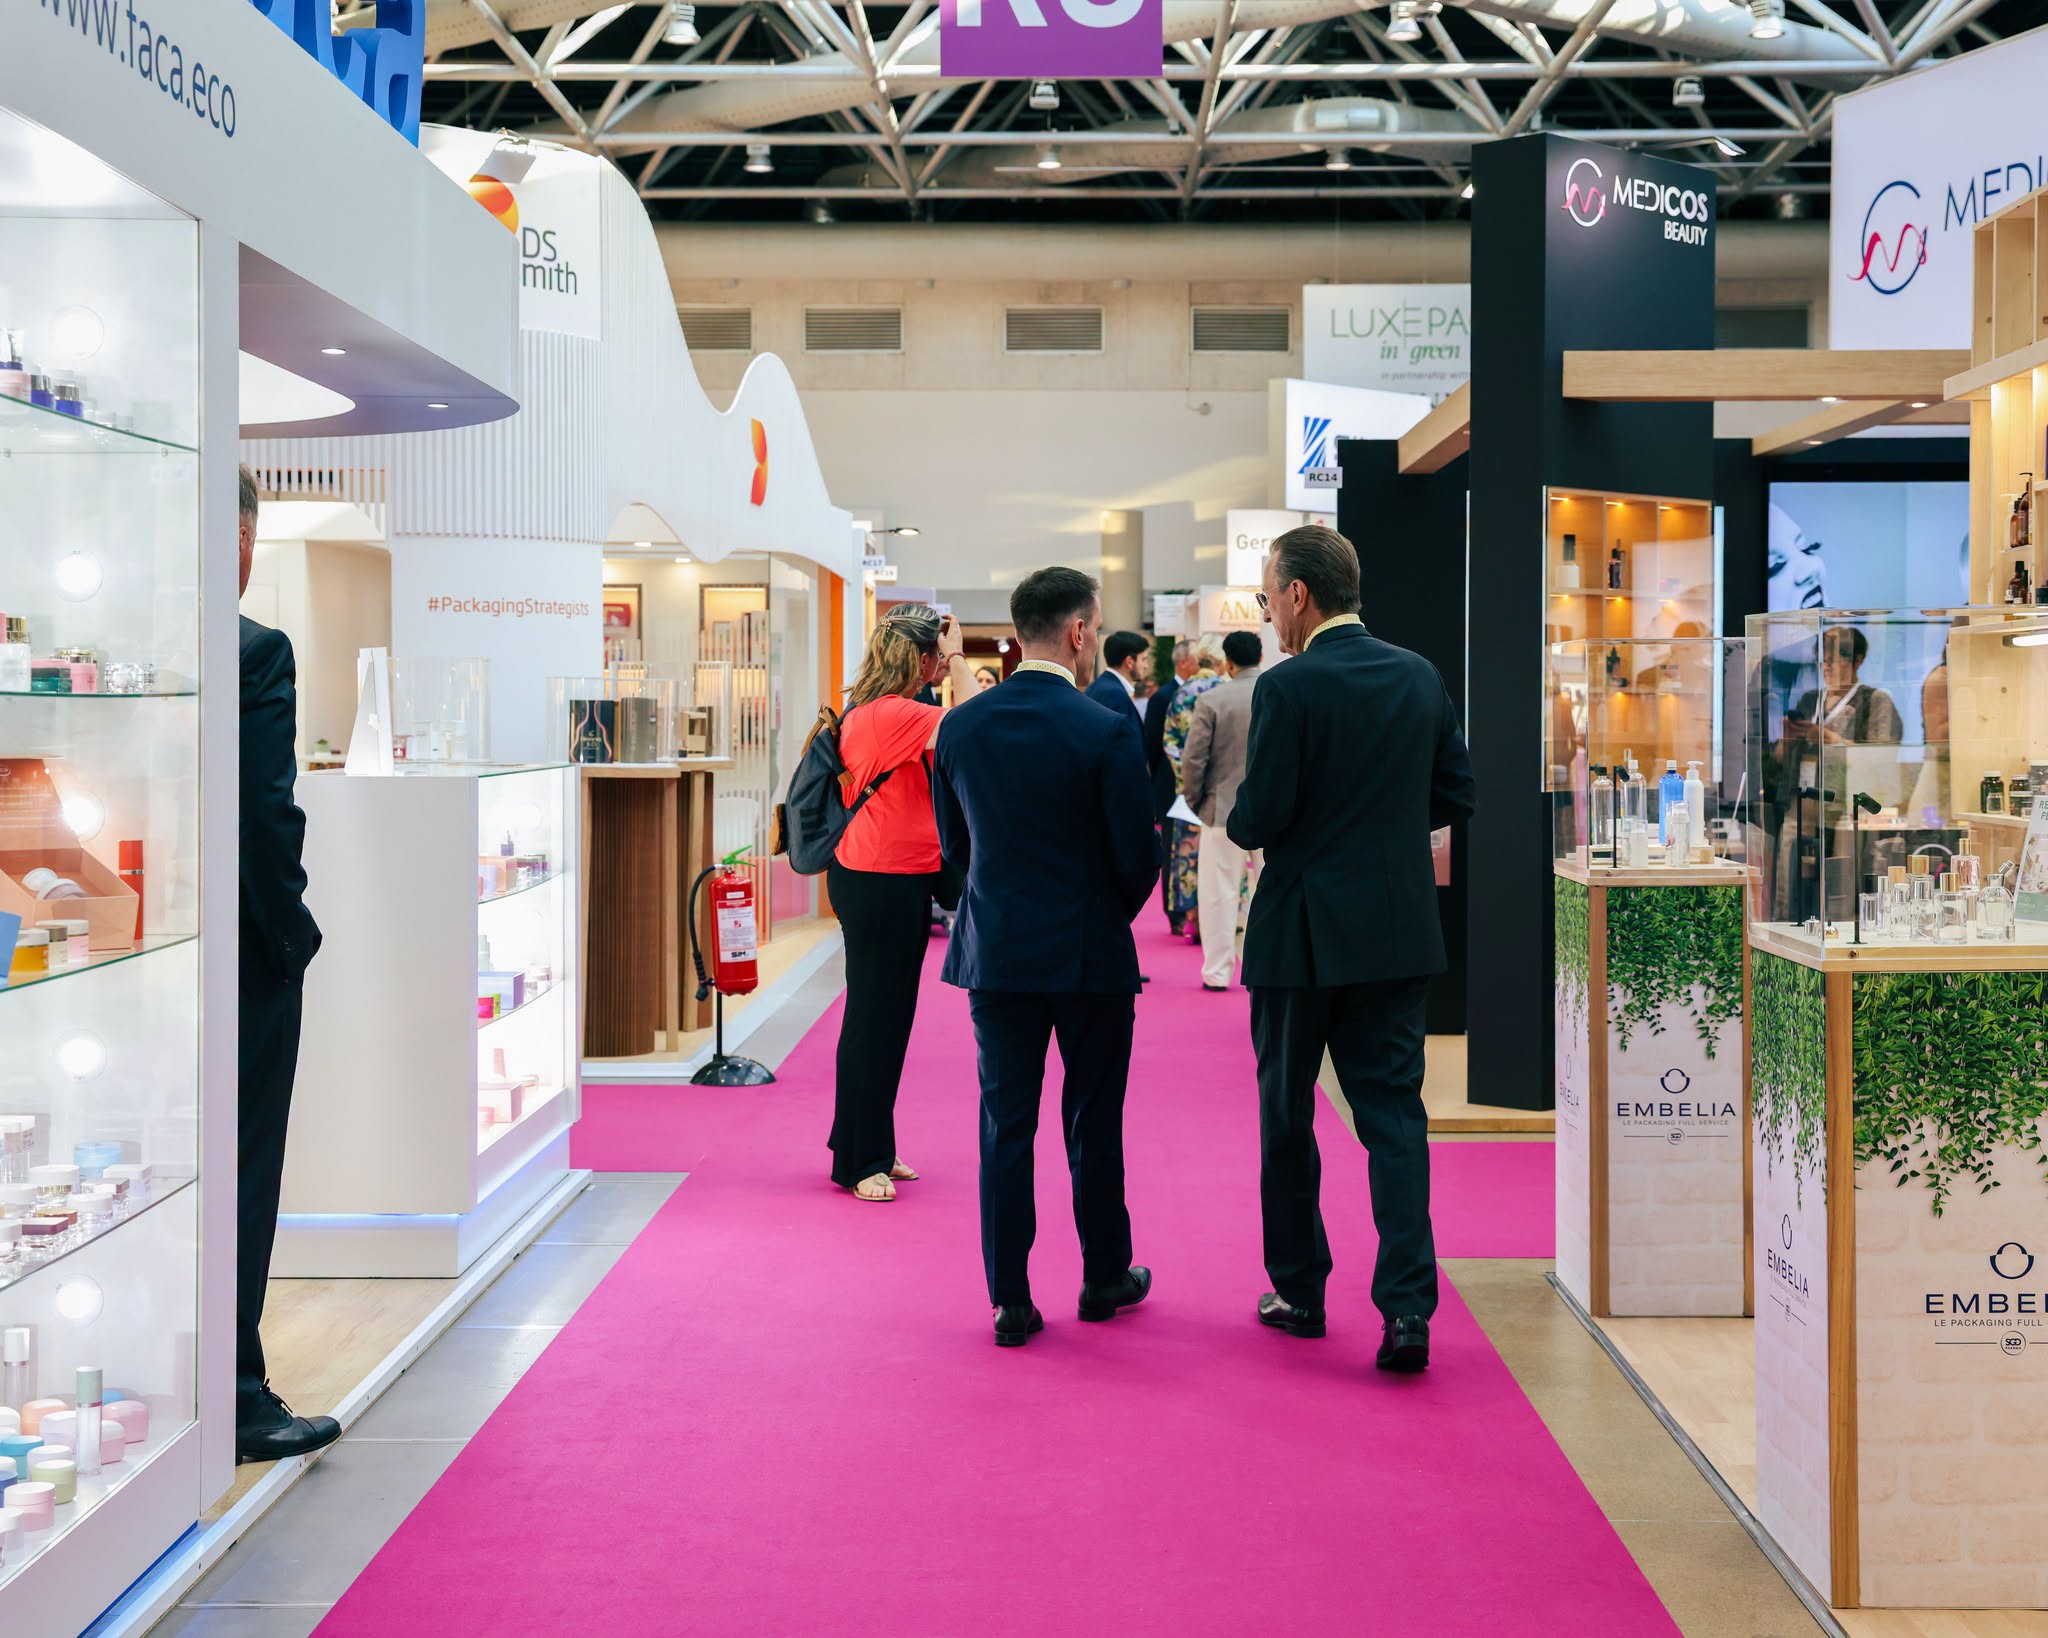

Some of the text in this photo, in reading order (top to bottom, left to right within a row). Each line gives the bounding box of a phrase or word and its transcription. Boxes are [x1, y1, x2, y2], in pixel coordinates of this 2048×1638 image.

[1613, 175, 1709, 223] MEDICOS
[1944, 156, 2048, 231] MEDI
[522, 226, 557, 262] DS
[1663, 220, 1708, 246] BEAUTY
[522, 261, 577, 295] mith
[1331, 305, 1471, 339] LUXEPA
[1380, 340, 1461, 366] in green
[1308, 472, 1338, 482] RC14
[1236, 534, 1277, 551] Ger
[428, 596, 589, 618] #PackagingStrategists
[1617, 1102, 1737, 1117] EMBELIA
[1767, 1248, 1809, 1298] EMBELIA
[1925, 1293, 2048, 1314] EMBE
[1934, 1319, 2043, 1327] LE PACKAGING FULL
[2005, 1338, 2022, 1346] SGD
